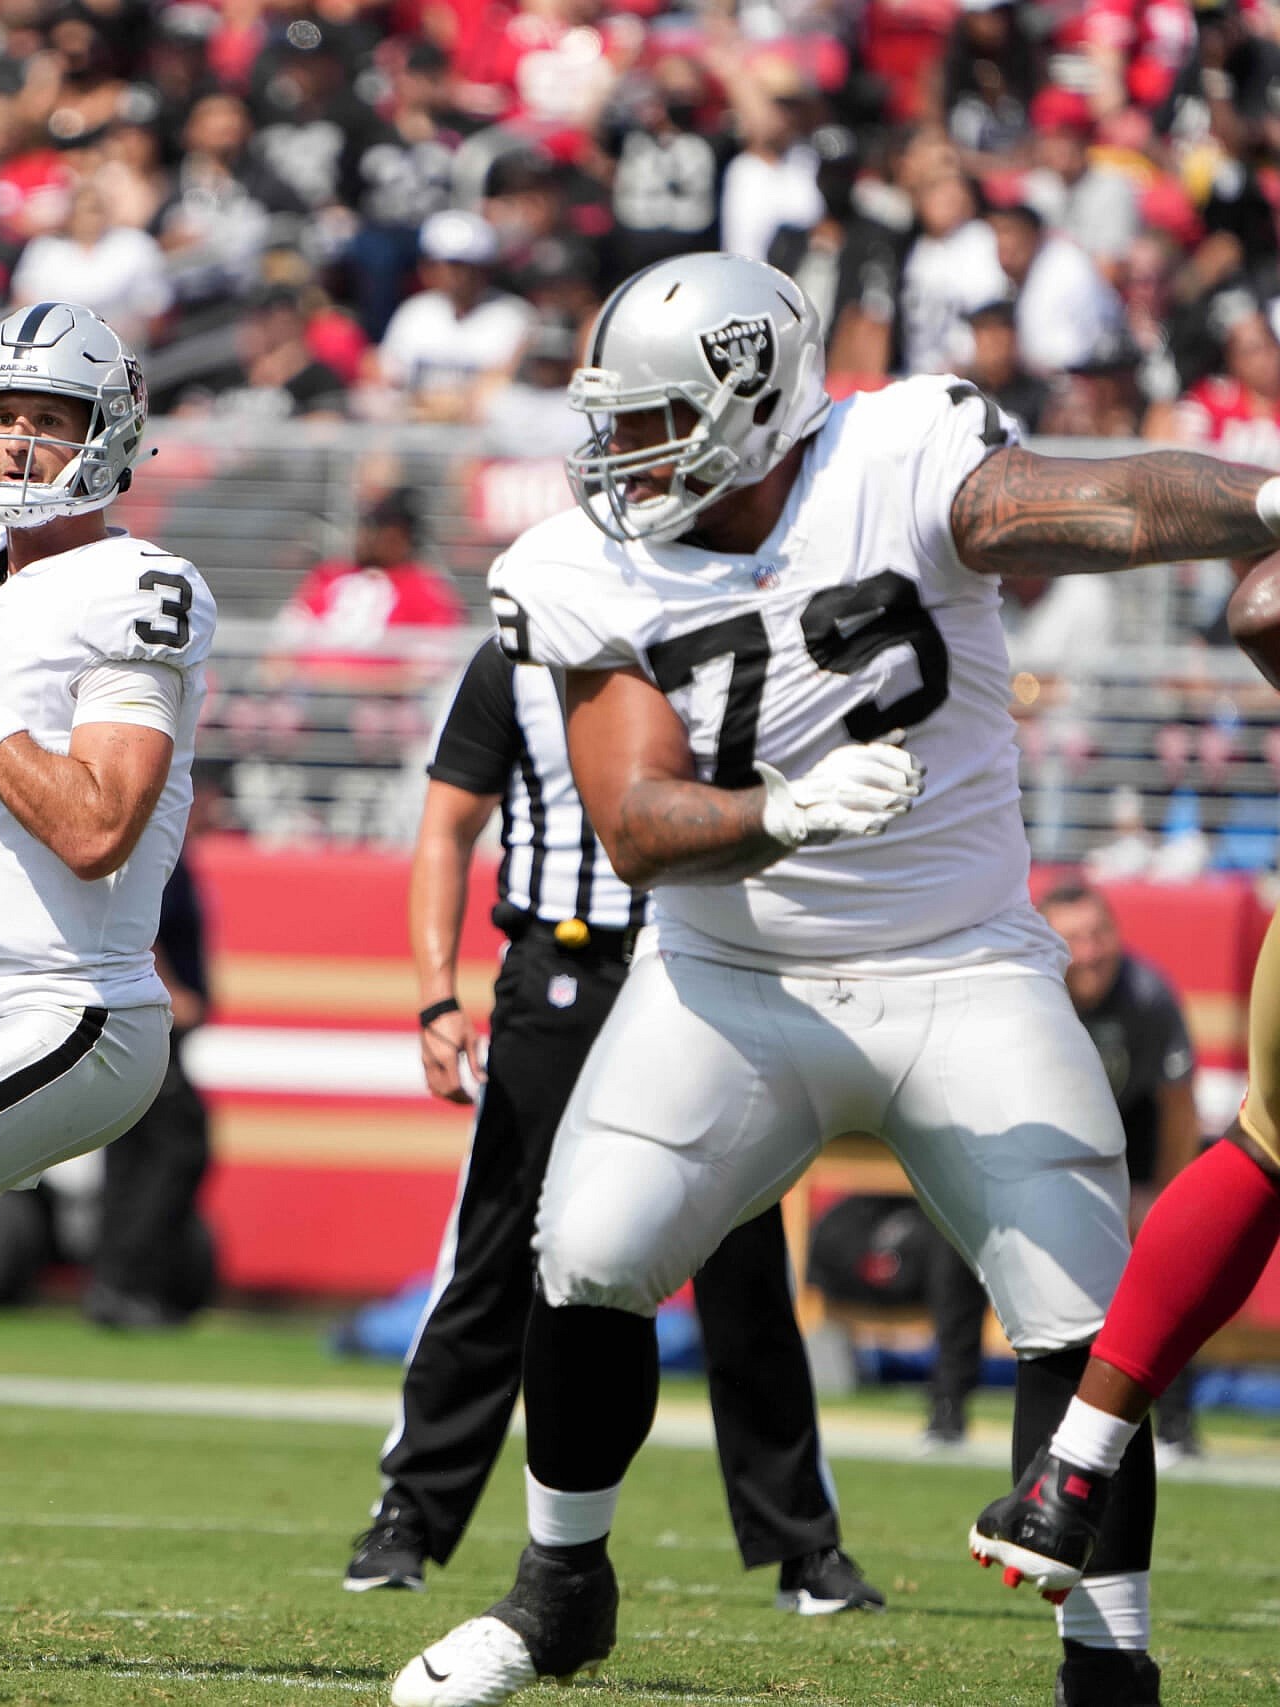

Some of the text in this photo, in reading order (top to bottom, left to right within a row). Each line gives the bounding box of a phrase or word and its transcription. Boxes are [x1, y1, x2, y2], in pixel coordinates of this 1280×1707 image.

[705, 320, 767, 345] RAIDERS
[0, 363, 39, 373] RAIDRS
[134, 569, 193, 650] 3
[646, 568, 950, 790] 79
